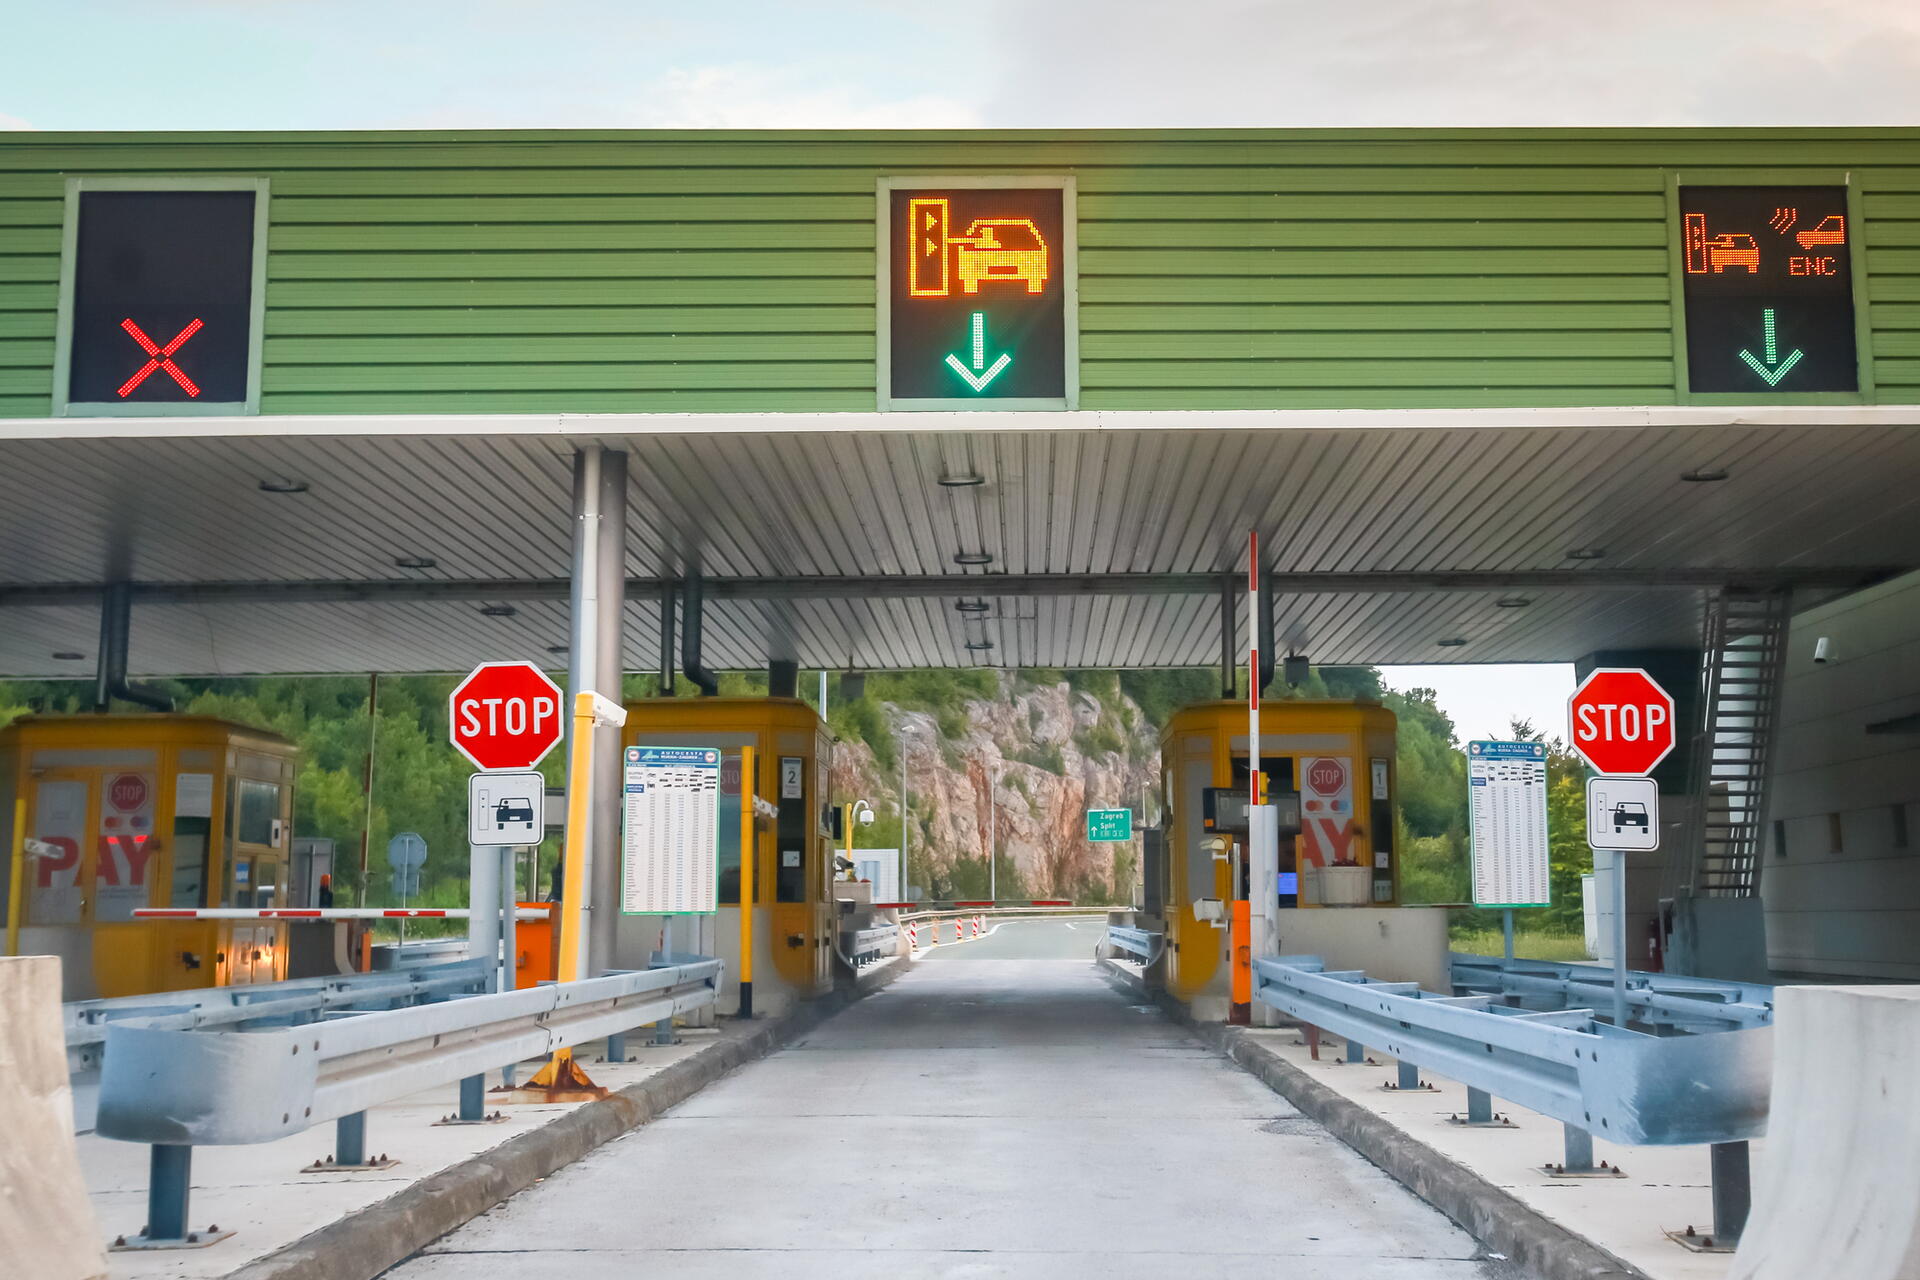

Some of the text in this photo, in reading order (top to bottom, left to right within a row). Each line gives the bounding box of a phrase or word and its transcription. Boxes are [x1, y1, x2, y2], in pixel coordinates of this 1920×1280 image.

[1789, 257, 1836, 276] ENC
[460, 696, 554, 738] STOP
[1578, 703, 1666, 742] STOP
[788, 770, 796, 784] 2
[1313, 769, 1339, 785] STOP
[1376, 772, 1382, 785] 1
[114, 784, 142, 800] STOP
[1100, 813, 1124, 821] Zagreb
[1100, 822, 1116, 830] Split
[38, 834, 151, 888] PAY
